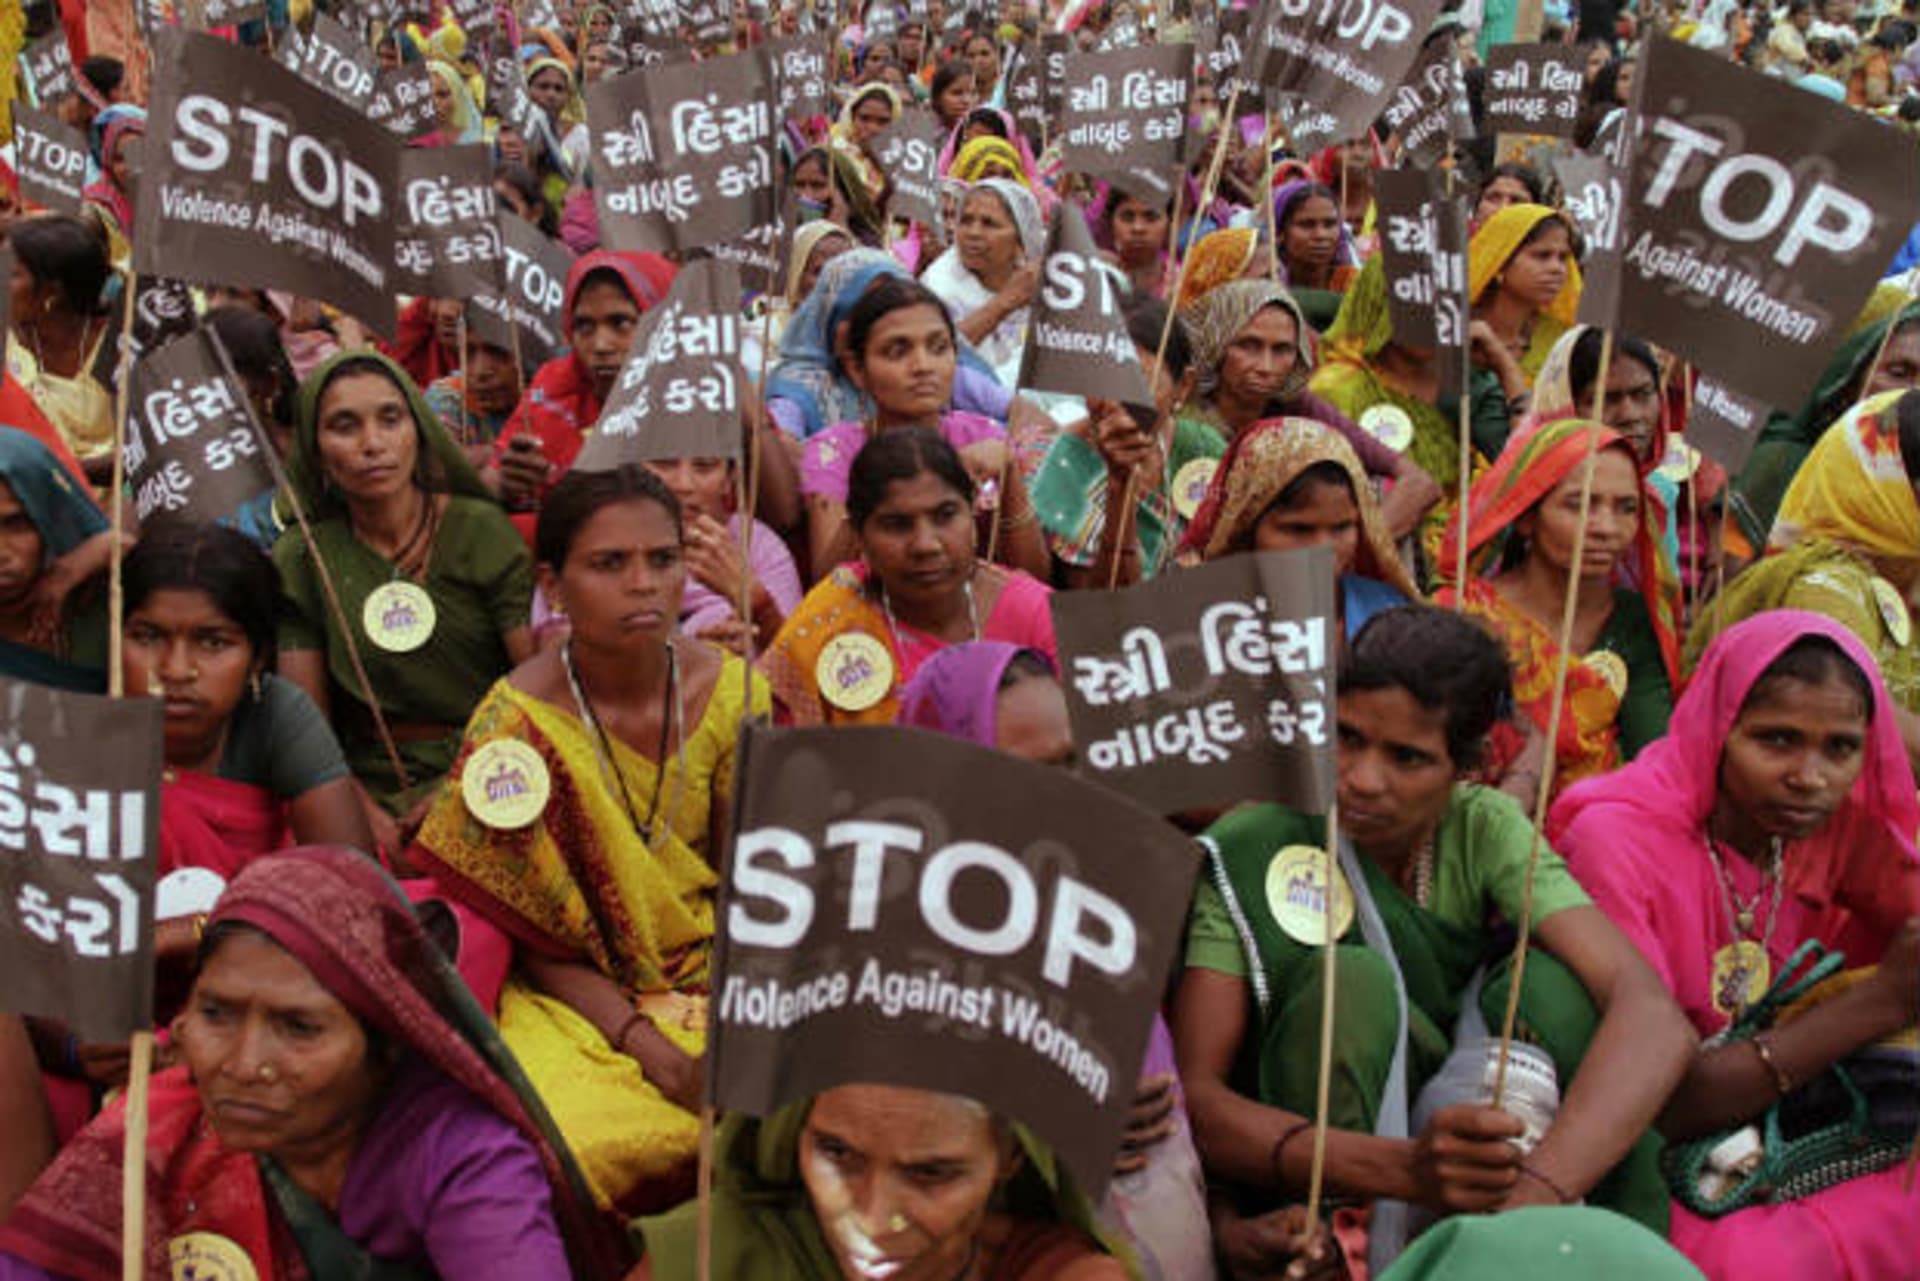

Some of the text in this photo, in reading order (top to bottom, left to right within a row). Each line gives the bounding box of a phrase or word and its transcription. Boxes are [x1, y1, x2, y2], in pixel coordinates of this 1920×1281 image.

[171, 94, 383, 227] STOP
[671, 92, 769, 154] હિંસા
[161, 184, 251, 229] Violence
[254, 203, 328, 251] Against
[406, 175, 496, 225] હિંસા
[607, 174, 700, 222] નાબૂદ
[1636, 116, 1874, 268] TOP
[1625, 230, 1818, 345] Against Women
[664, 361, 736, 413] કરો
[1073, 626, 1171, 705] સ્ત્રી
[1088, 701, 1245, 769] નાબૂદ
[16, 872, 140, 957] કરો
[727, 820, 1136, 989] STOP
[853, 956, 994, 1030] Against
[1001, 992, 1111, 1106] Women
